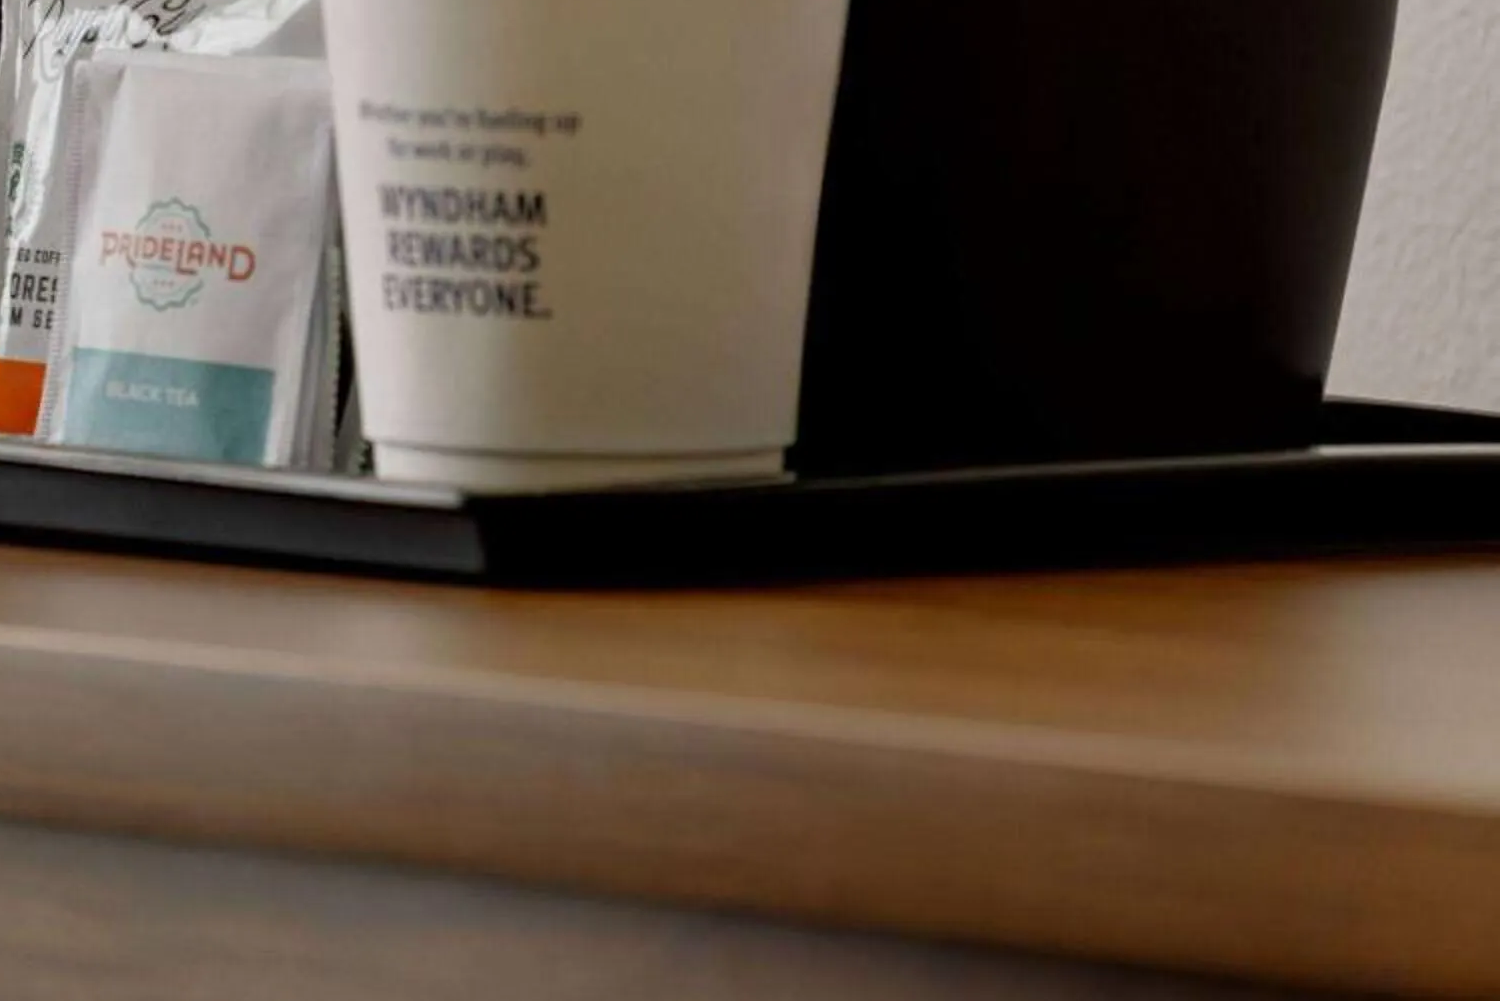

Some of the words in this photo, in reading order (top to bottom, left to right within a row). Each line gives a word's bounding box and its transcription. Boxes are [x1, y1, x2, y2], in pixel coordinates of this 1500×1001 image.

[376, 184, 547, 227] WYNDHAM
[100, 231, 256, 282] PRIDELAND
[387, 230, 541, 272] REWARDS
[381, 274, 553, 320] EVERYONE.
[165, 388, 200, 407] TEA
